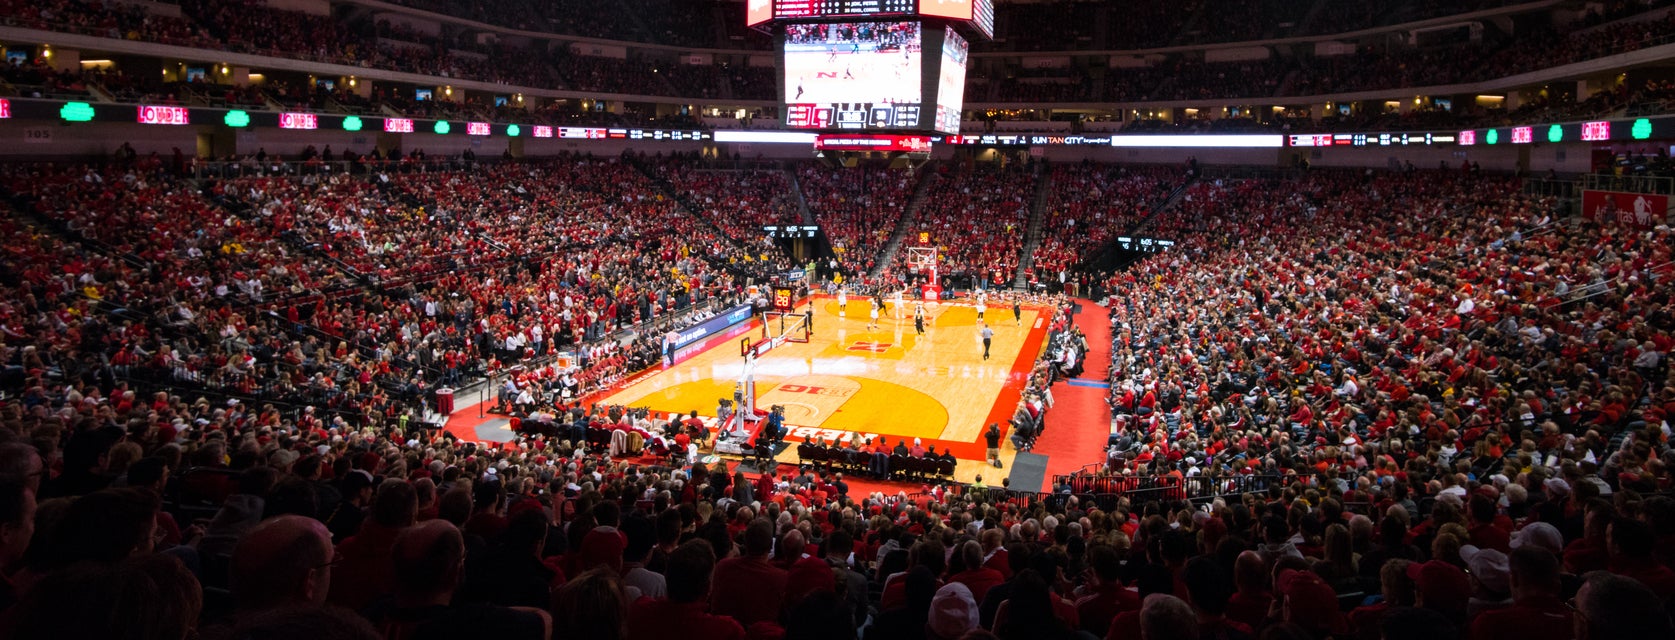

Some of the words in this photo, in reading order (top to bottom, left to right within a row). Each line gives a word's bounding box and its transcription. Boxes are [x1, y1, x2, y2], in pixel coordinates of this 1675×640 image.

[137, 105, 189, 124] LOUDER
[279, 113, 317, 129] LOUDER
[384, 118, 414, 132] LOUDER
[1581, 121, 1610, 141] LOUDER
[1032, 136, 1047, 144] SUN
[1048, 136, 1064, 144] TAN
[1064, 136, 1084, 144] CITY
[776, 296, 789, 307] 28
